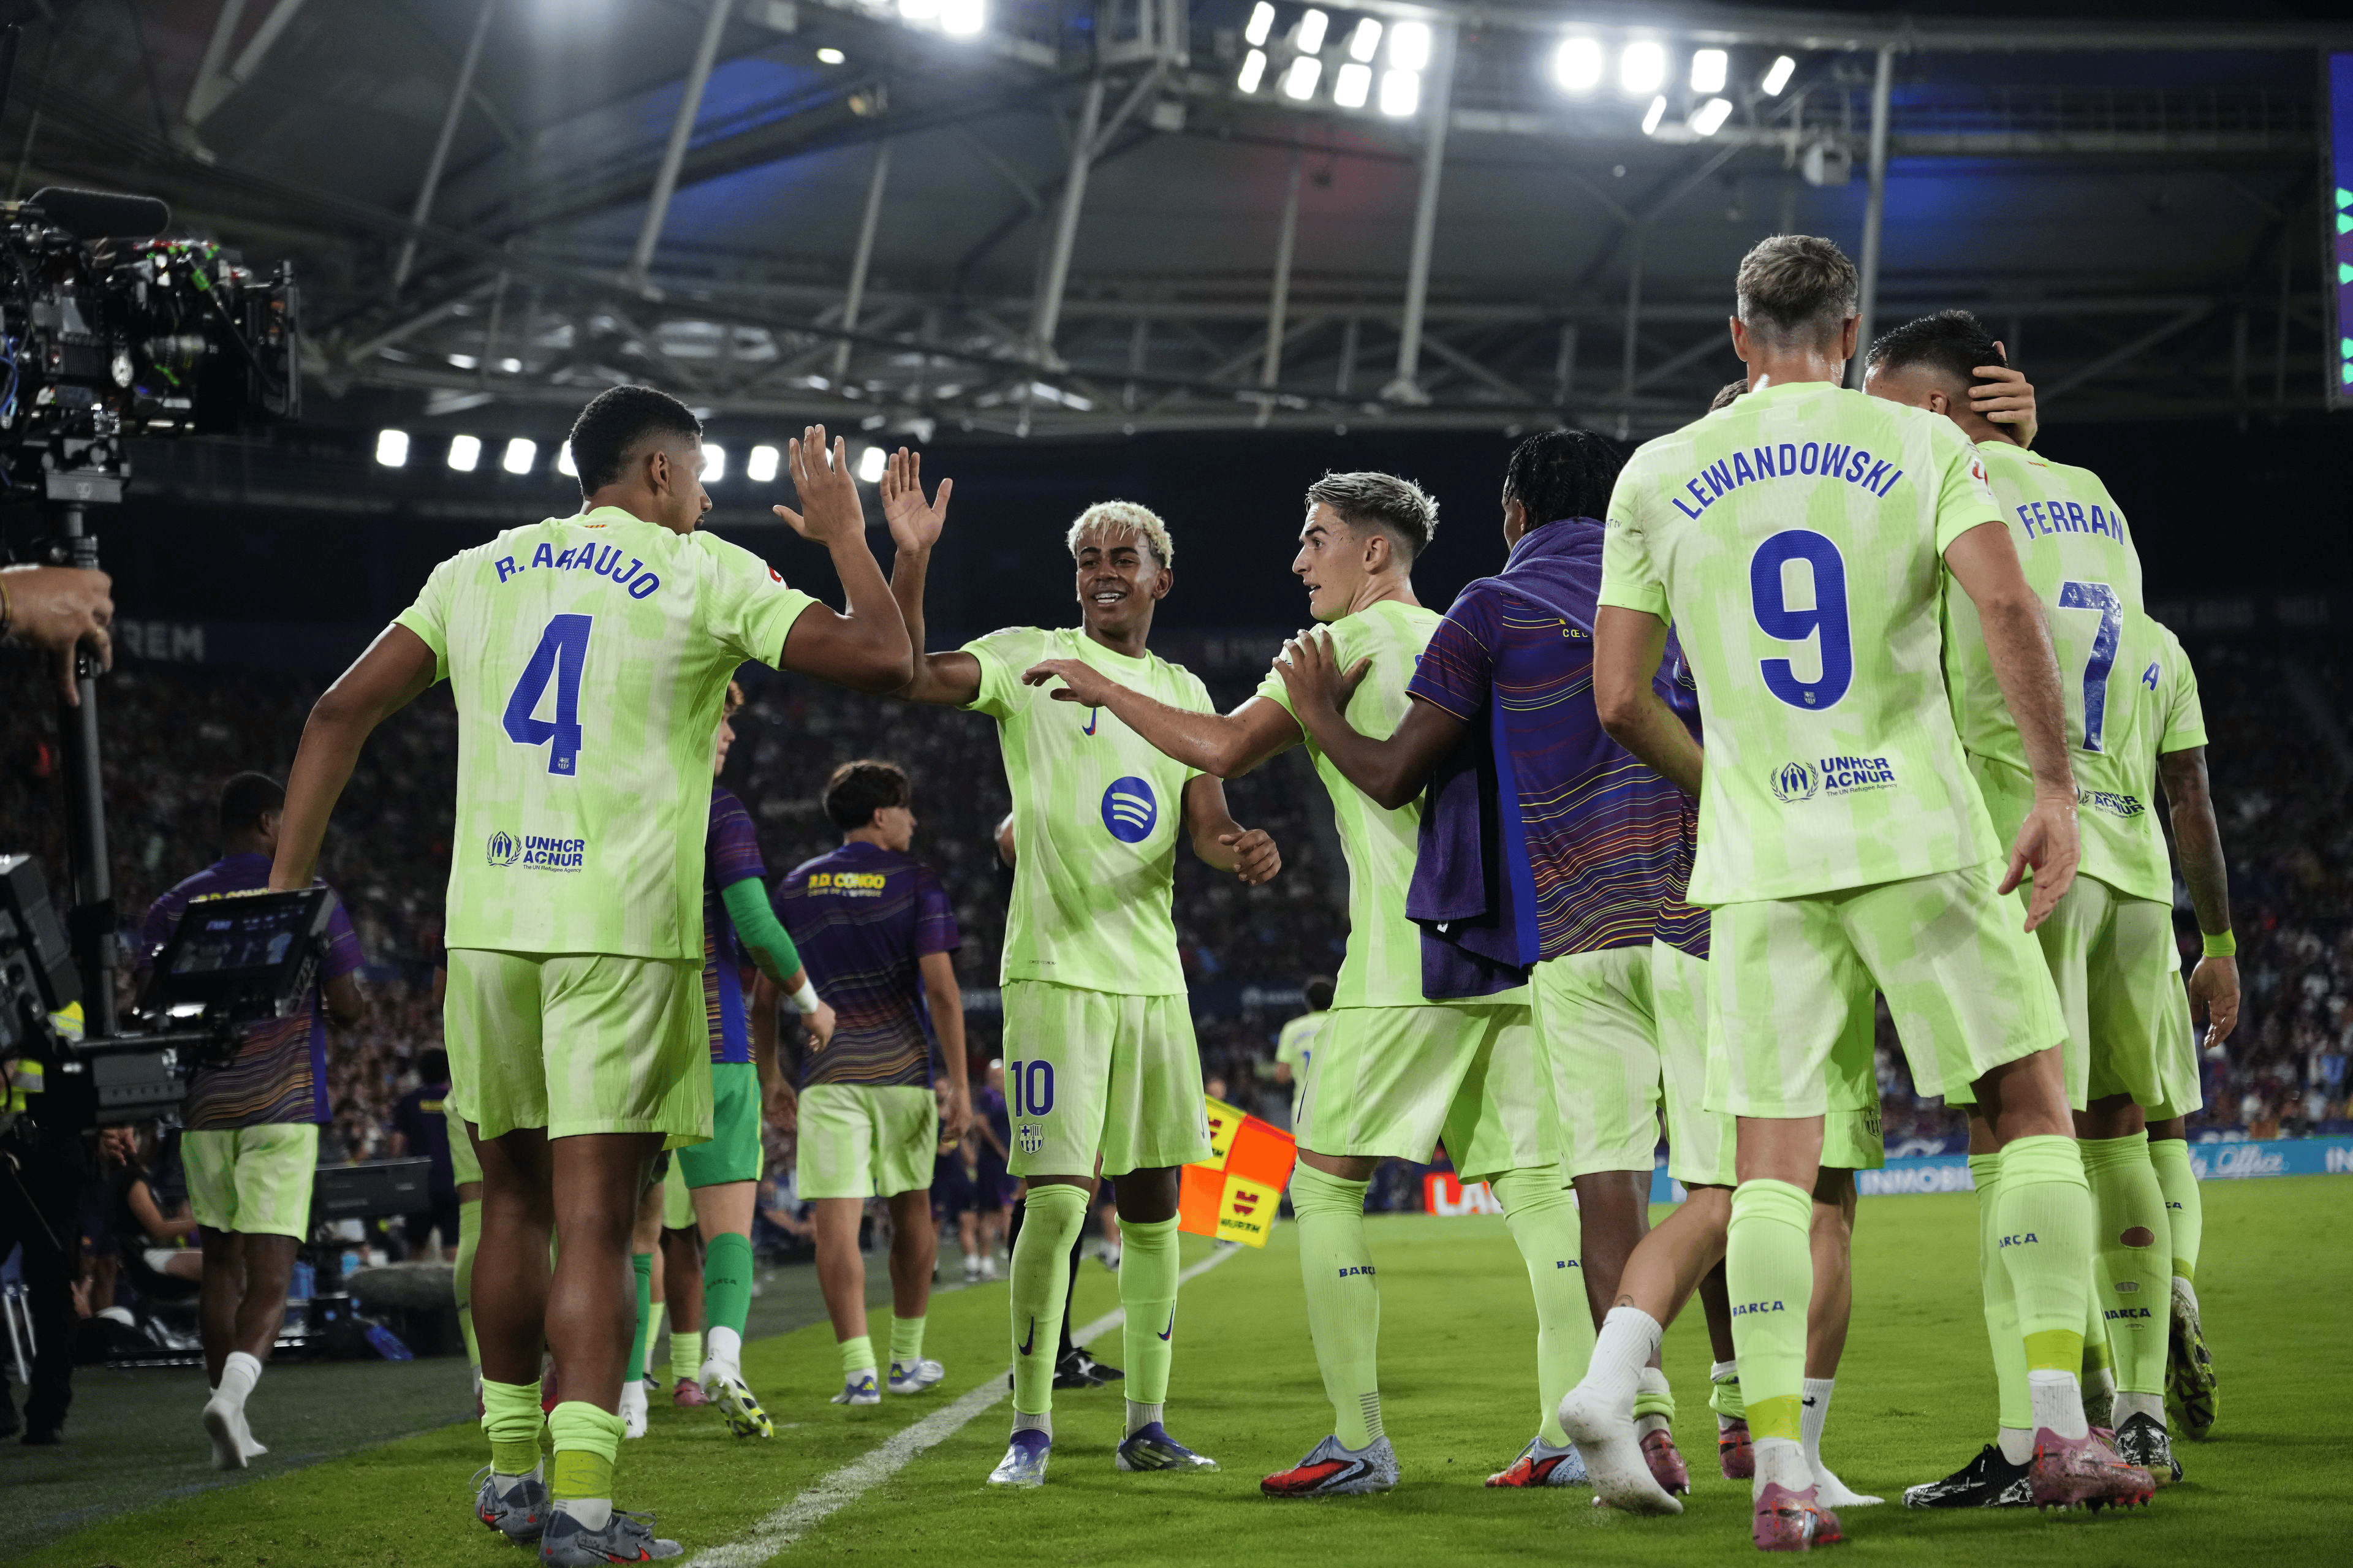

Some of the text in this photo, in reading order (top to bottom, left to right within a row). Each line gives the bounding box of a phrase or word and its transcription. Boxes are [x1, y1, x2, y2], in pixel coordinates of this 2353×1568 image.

[1672, 442, 1904, 520] LEWANDOWSKI
[2016, 501, 2124, 547] FERRAN
[494, 542, 661, 600] R. ARAUJO
[1750, 529, 1853, 711] 9
[2058, 580, 2124, 754] 7
[2142, 661, 2161, 692] A
[502, 613, 594, 778] 4
[1820, 756, 1890, 773] UNHCR
[1825, 770, 1896, 790] ACNUR
[1850, 784, 1876, 793] Refugee
[2094, 795, 2145, 815] ACNUR
[523, 850, 583, 866] ACNUR
[525, 835, 585, 852] UNHCR
[1010, 1059, 1055, 1118] 10
[1556, 1260, 1582, 1269] BA
